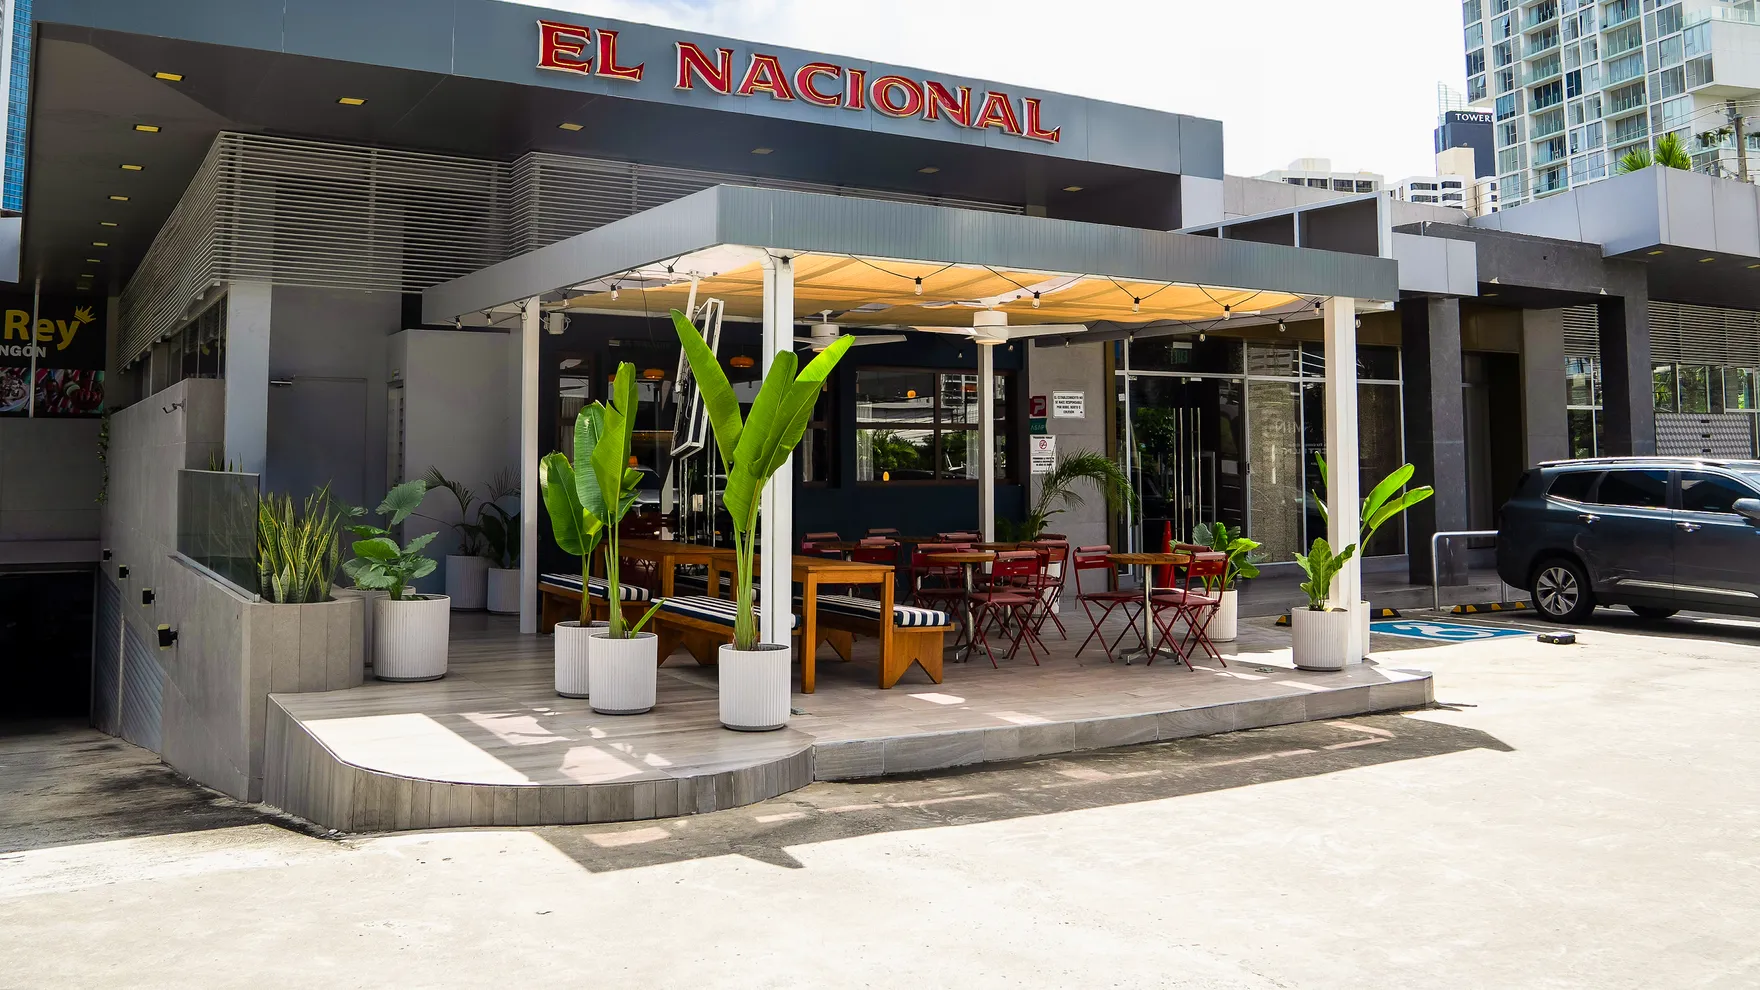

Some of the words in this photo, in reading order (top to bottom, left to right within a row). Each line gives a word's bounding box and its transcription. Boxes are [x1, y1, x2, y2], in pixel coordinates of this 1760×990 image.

[535, 19, 644, 82] EL
[673, 41, 1061, 144] NACIONAL
[1455, 113, 1494, 122] TOWER
[4, 309, 80, 350] Rey
